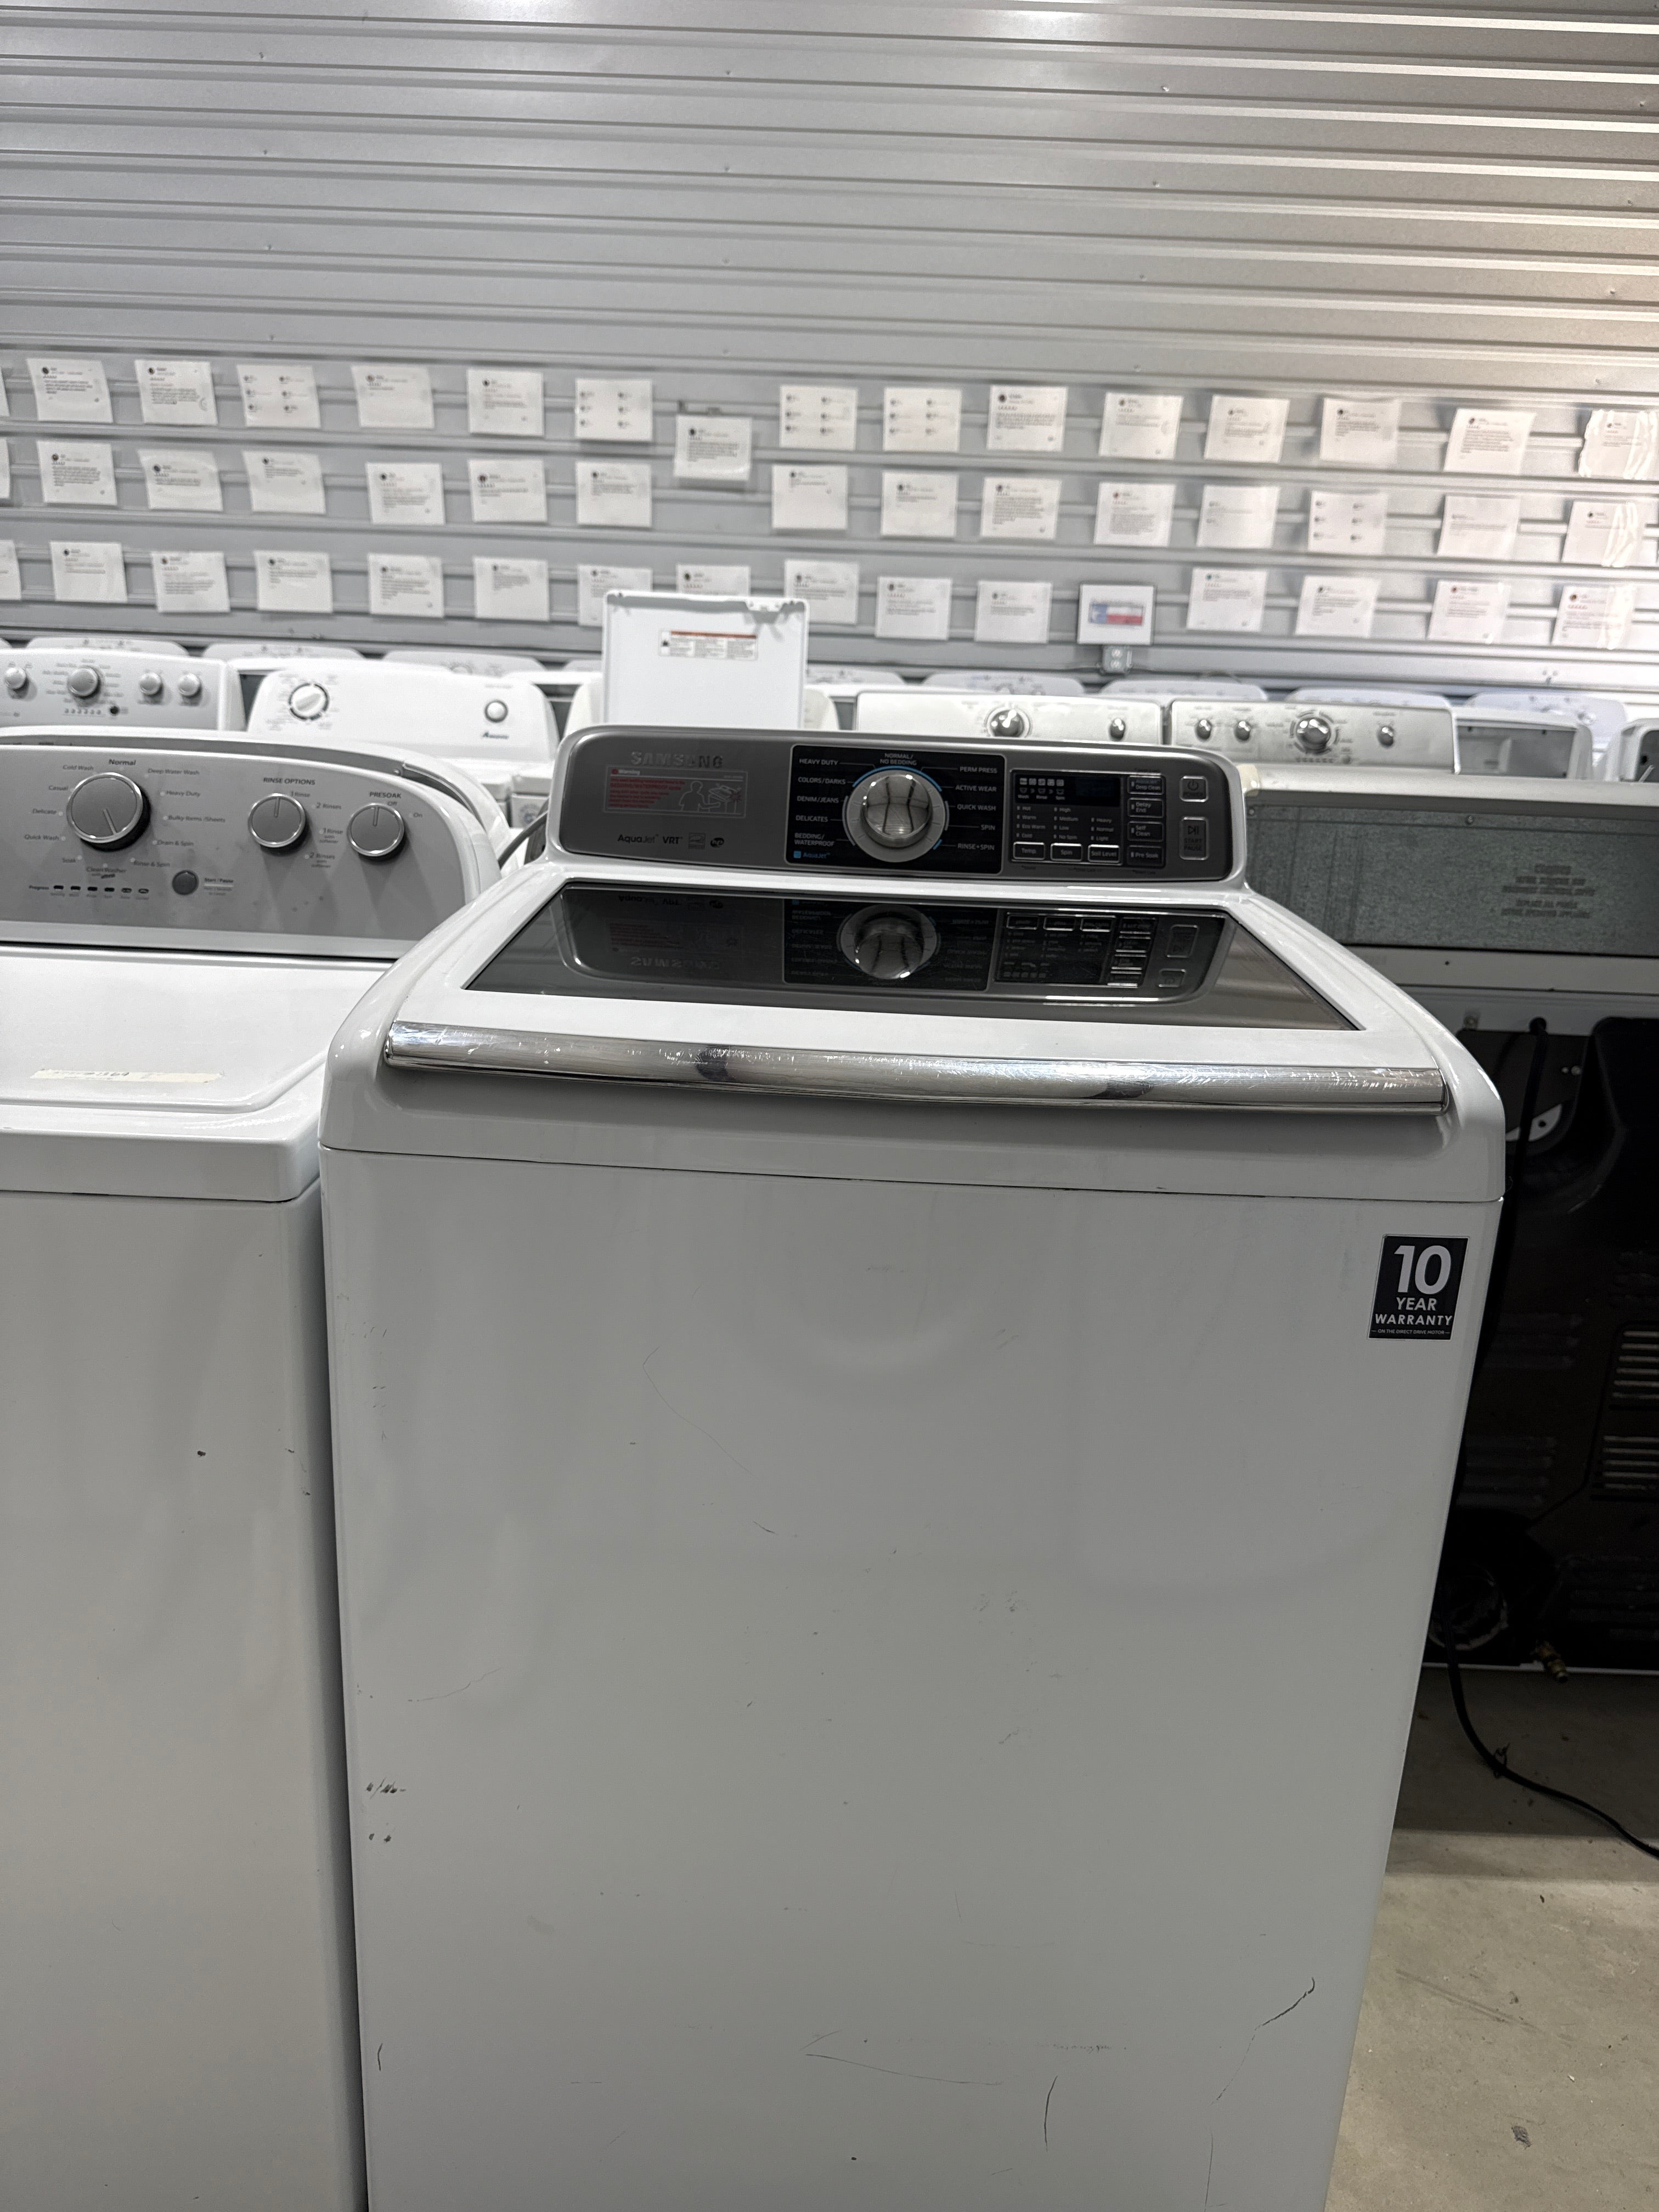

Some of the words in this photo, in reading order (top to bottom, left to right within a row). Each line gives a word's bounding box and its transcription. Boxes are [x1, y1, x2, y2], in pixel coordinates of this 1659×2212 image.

[631, 751, 723, 768] SAMSUNG
[1394, 1245, 1451, 1295] 10
[1396, 1297, 1437, 1311] YEAR
[1375, 1313, 1453, 1326] WARRANTY
